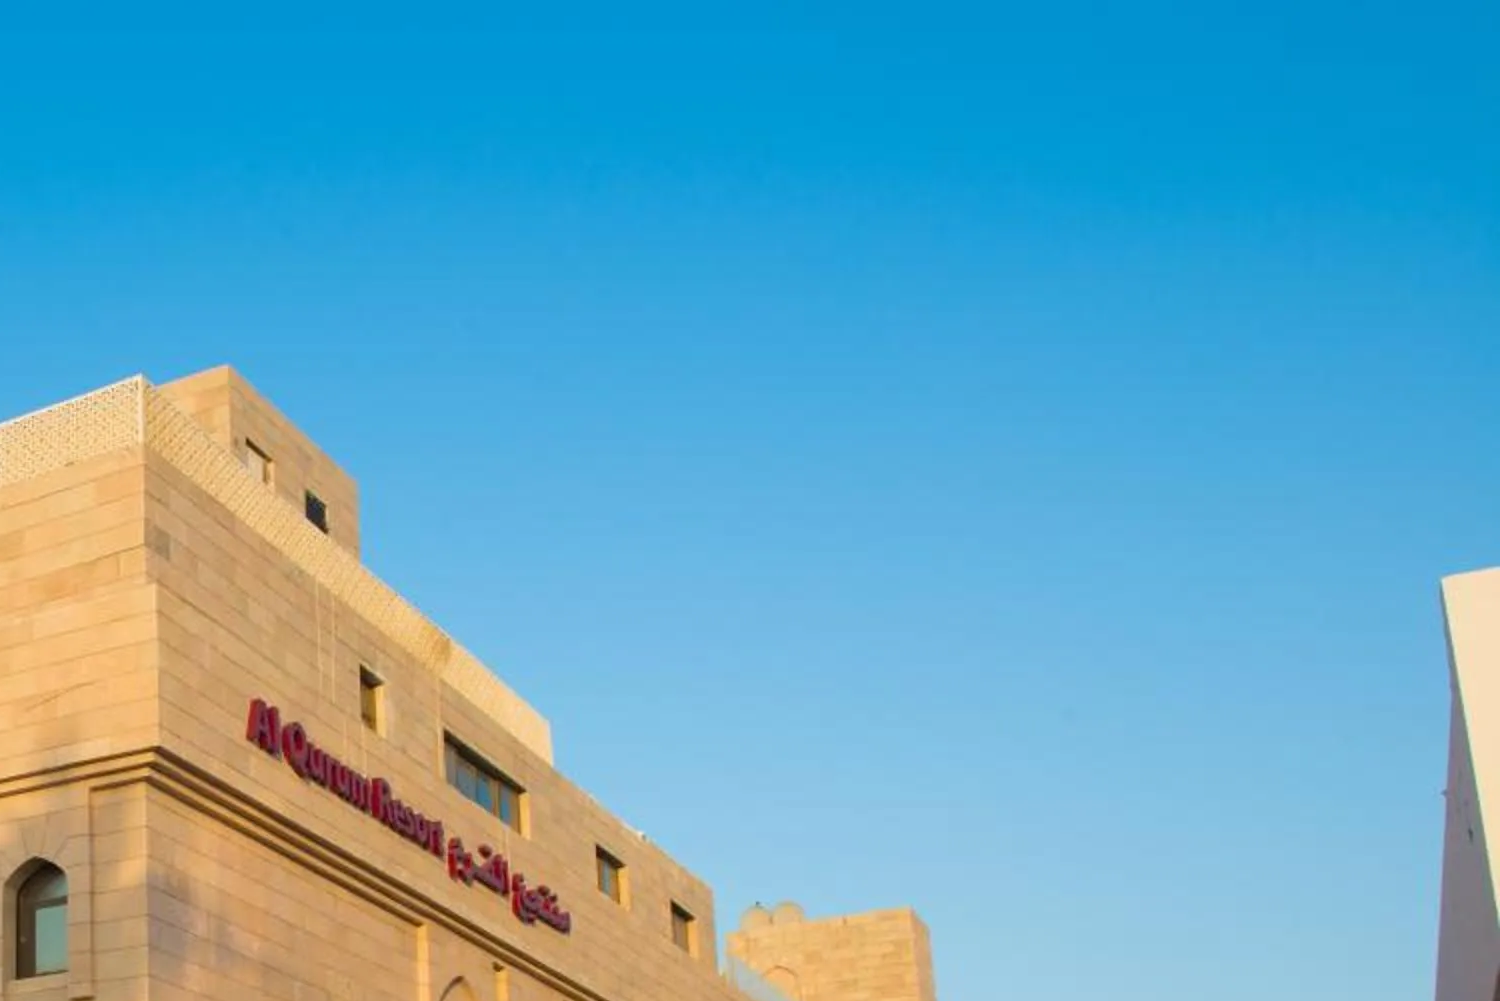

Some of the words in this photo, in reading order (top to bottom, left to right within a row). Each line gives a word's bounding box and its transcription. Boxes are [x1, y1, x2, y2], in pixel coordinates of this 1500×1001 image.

[246, 697, 281, 763] Al
[282, 721, 371, 815] Qurum
[371, 776, 445, 859] Resort
